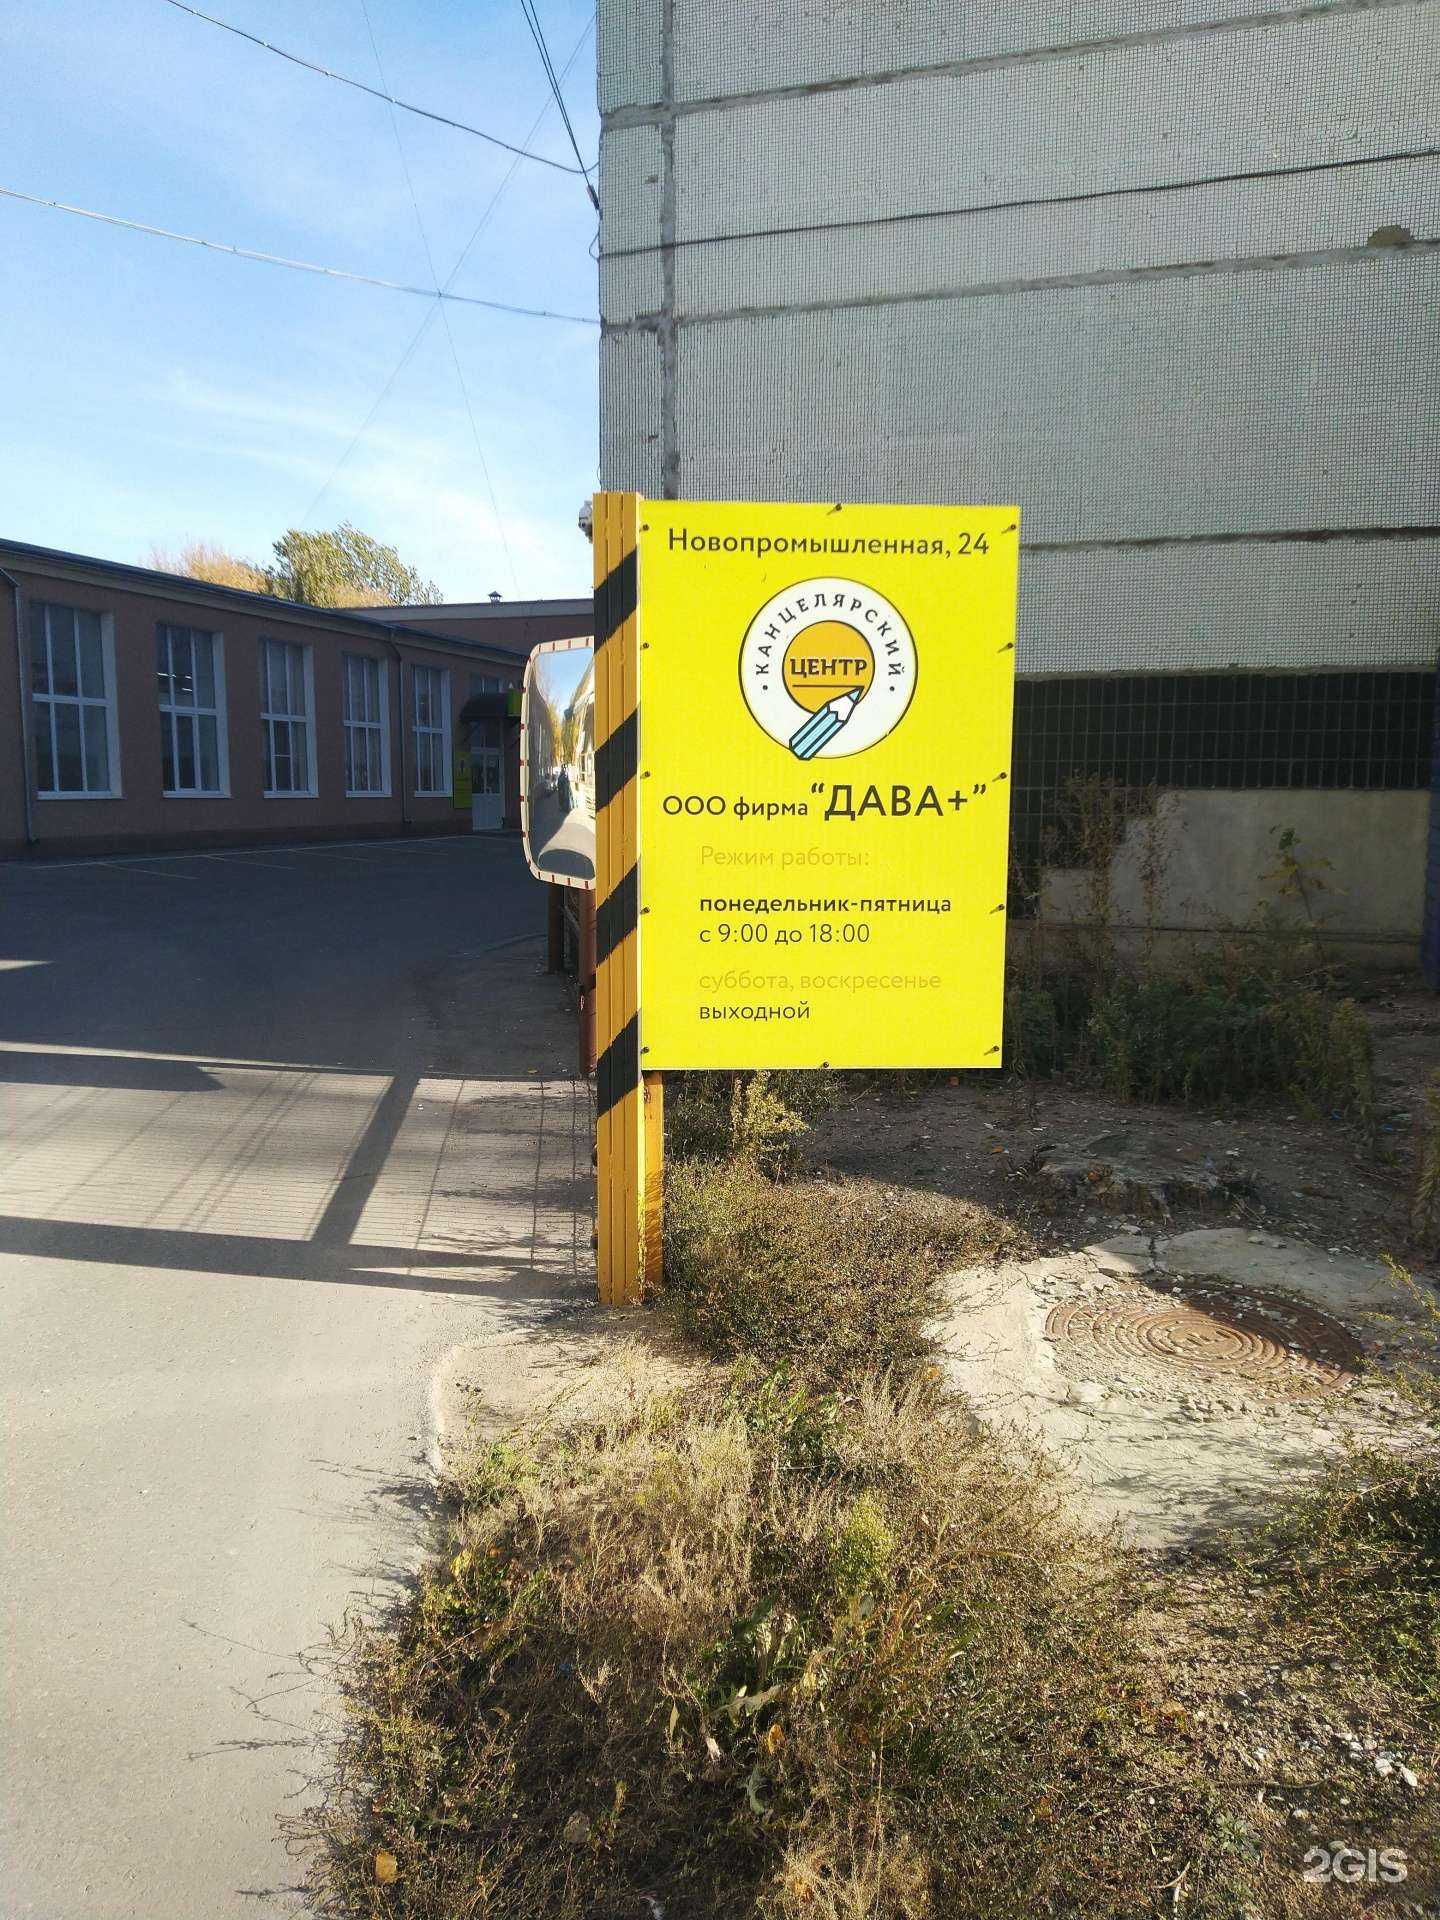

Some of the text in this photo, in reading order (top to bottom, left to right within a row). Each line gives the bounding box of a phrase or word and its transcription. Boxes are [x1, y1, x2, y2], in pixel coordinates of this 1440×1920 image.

[668, 527, 990, 558] Новопромышленная, 24
[755, 592, 906, 676] КАНЦЕЛЯРСКИЙ
[789, 658, 869, 679] ЦЕНТР
[662, 795, 726, 816] ООО
[733, 795, 809, 821] фирма
[700, 845, 869, 871] Режим работы:
[699, 897, 952, 915] понедельник-пятница
[699, 923, 870, 946] с 9:00 до 18:00
[699, 970, 942, 993] суббота, воскресенье
[699, 1001, 810, 1021] выходной
